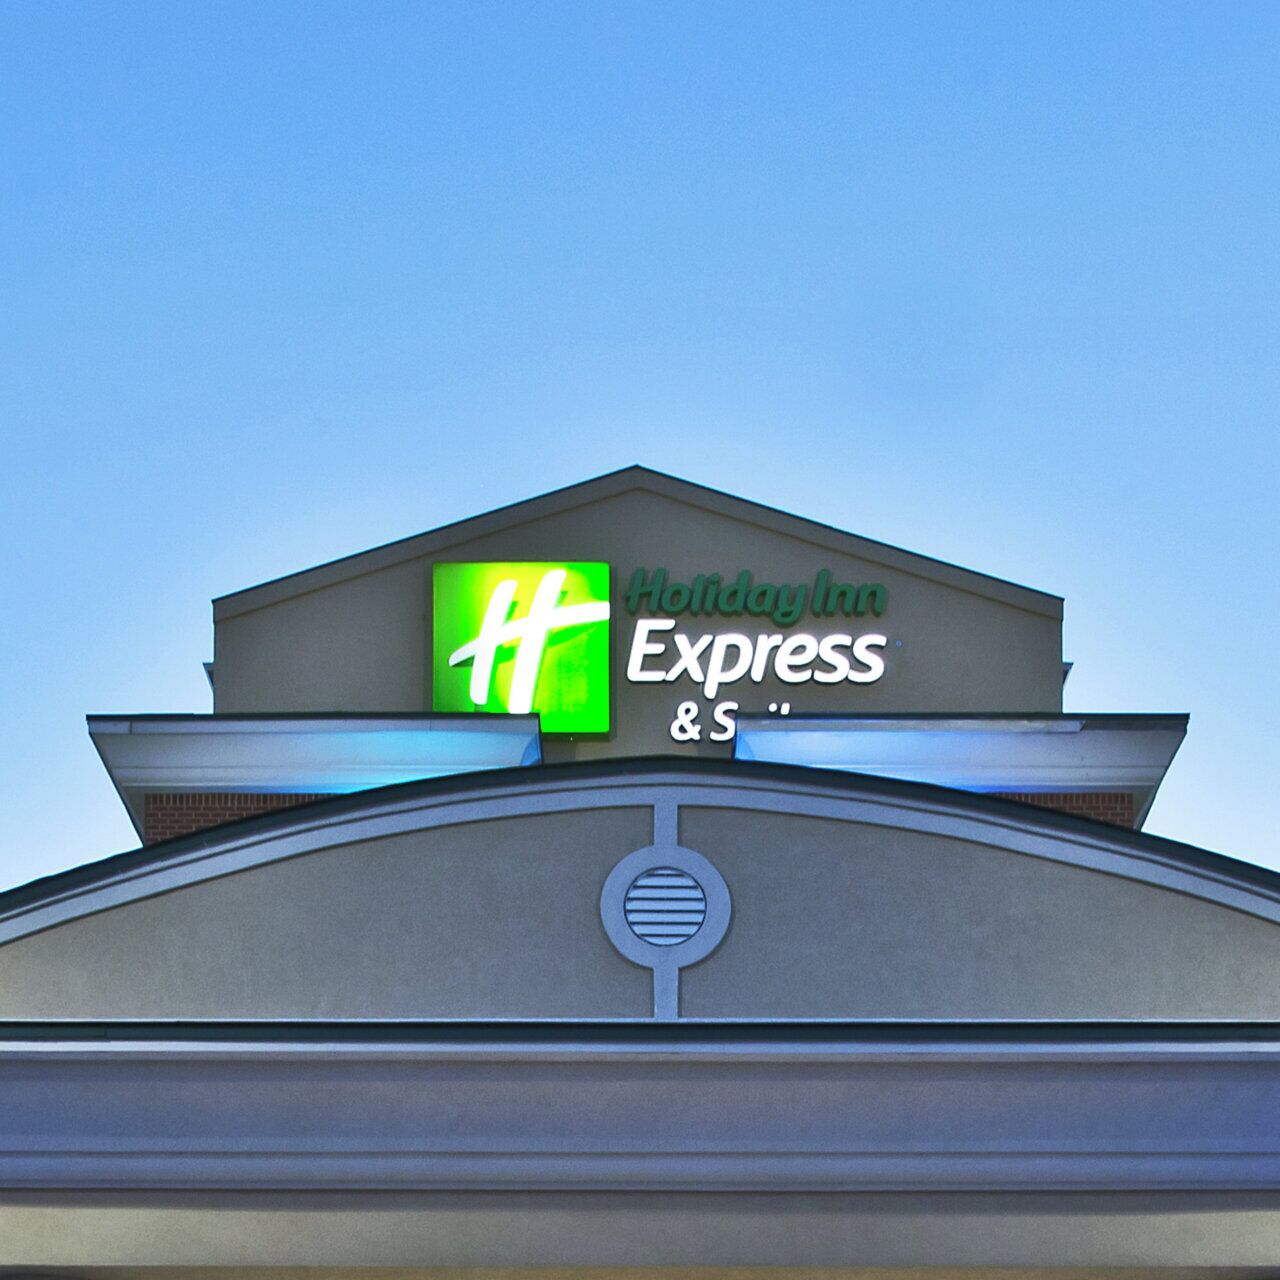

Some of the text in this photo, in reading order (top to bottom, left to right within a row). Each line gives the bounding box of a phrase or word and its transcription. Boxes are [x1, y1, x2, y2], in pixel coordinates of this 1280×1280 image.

[625, 567, 888, 625] Holiday Inn
[627, 619, 887, 699] Express
[670, 701, 702, 741] &
